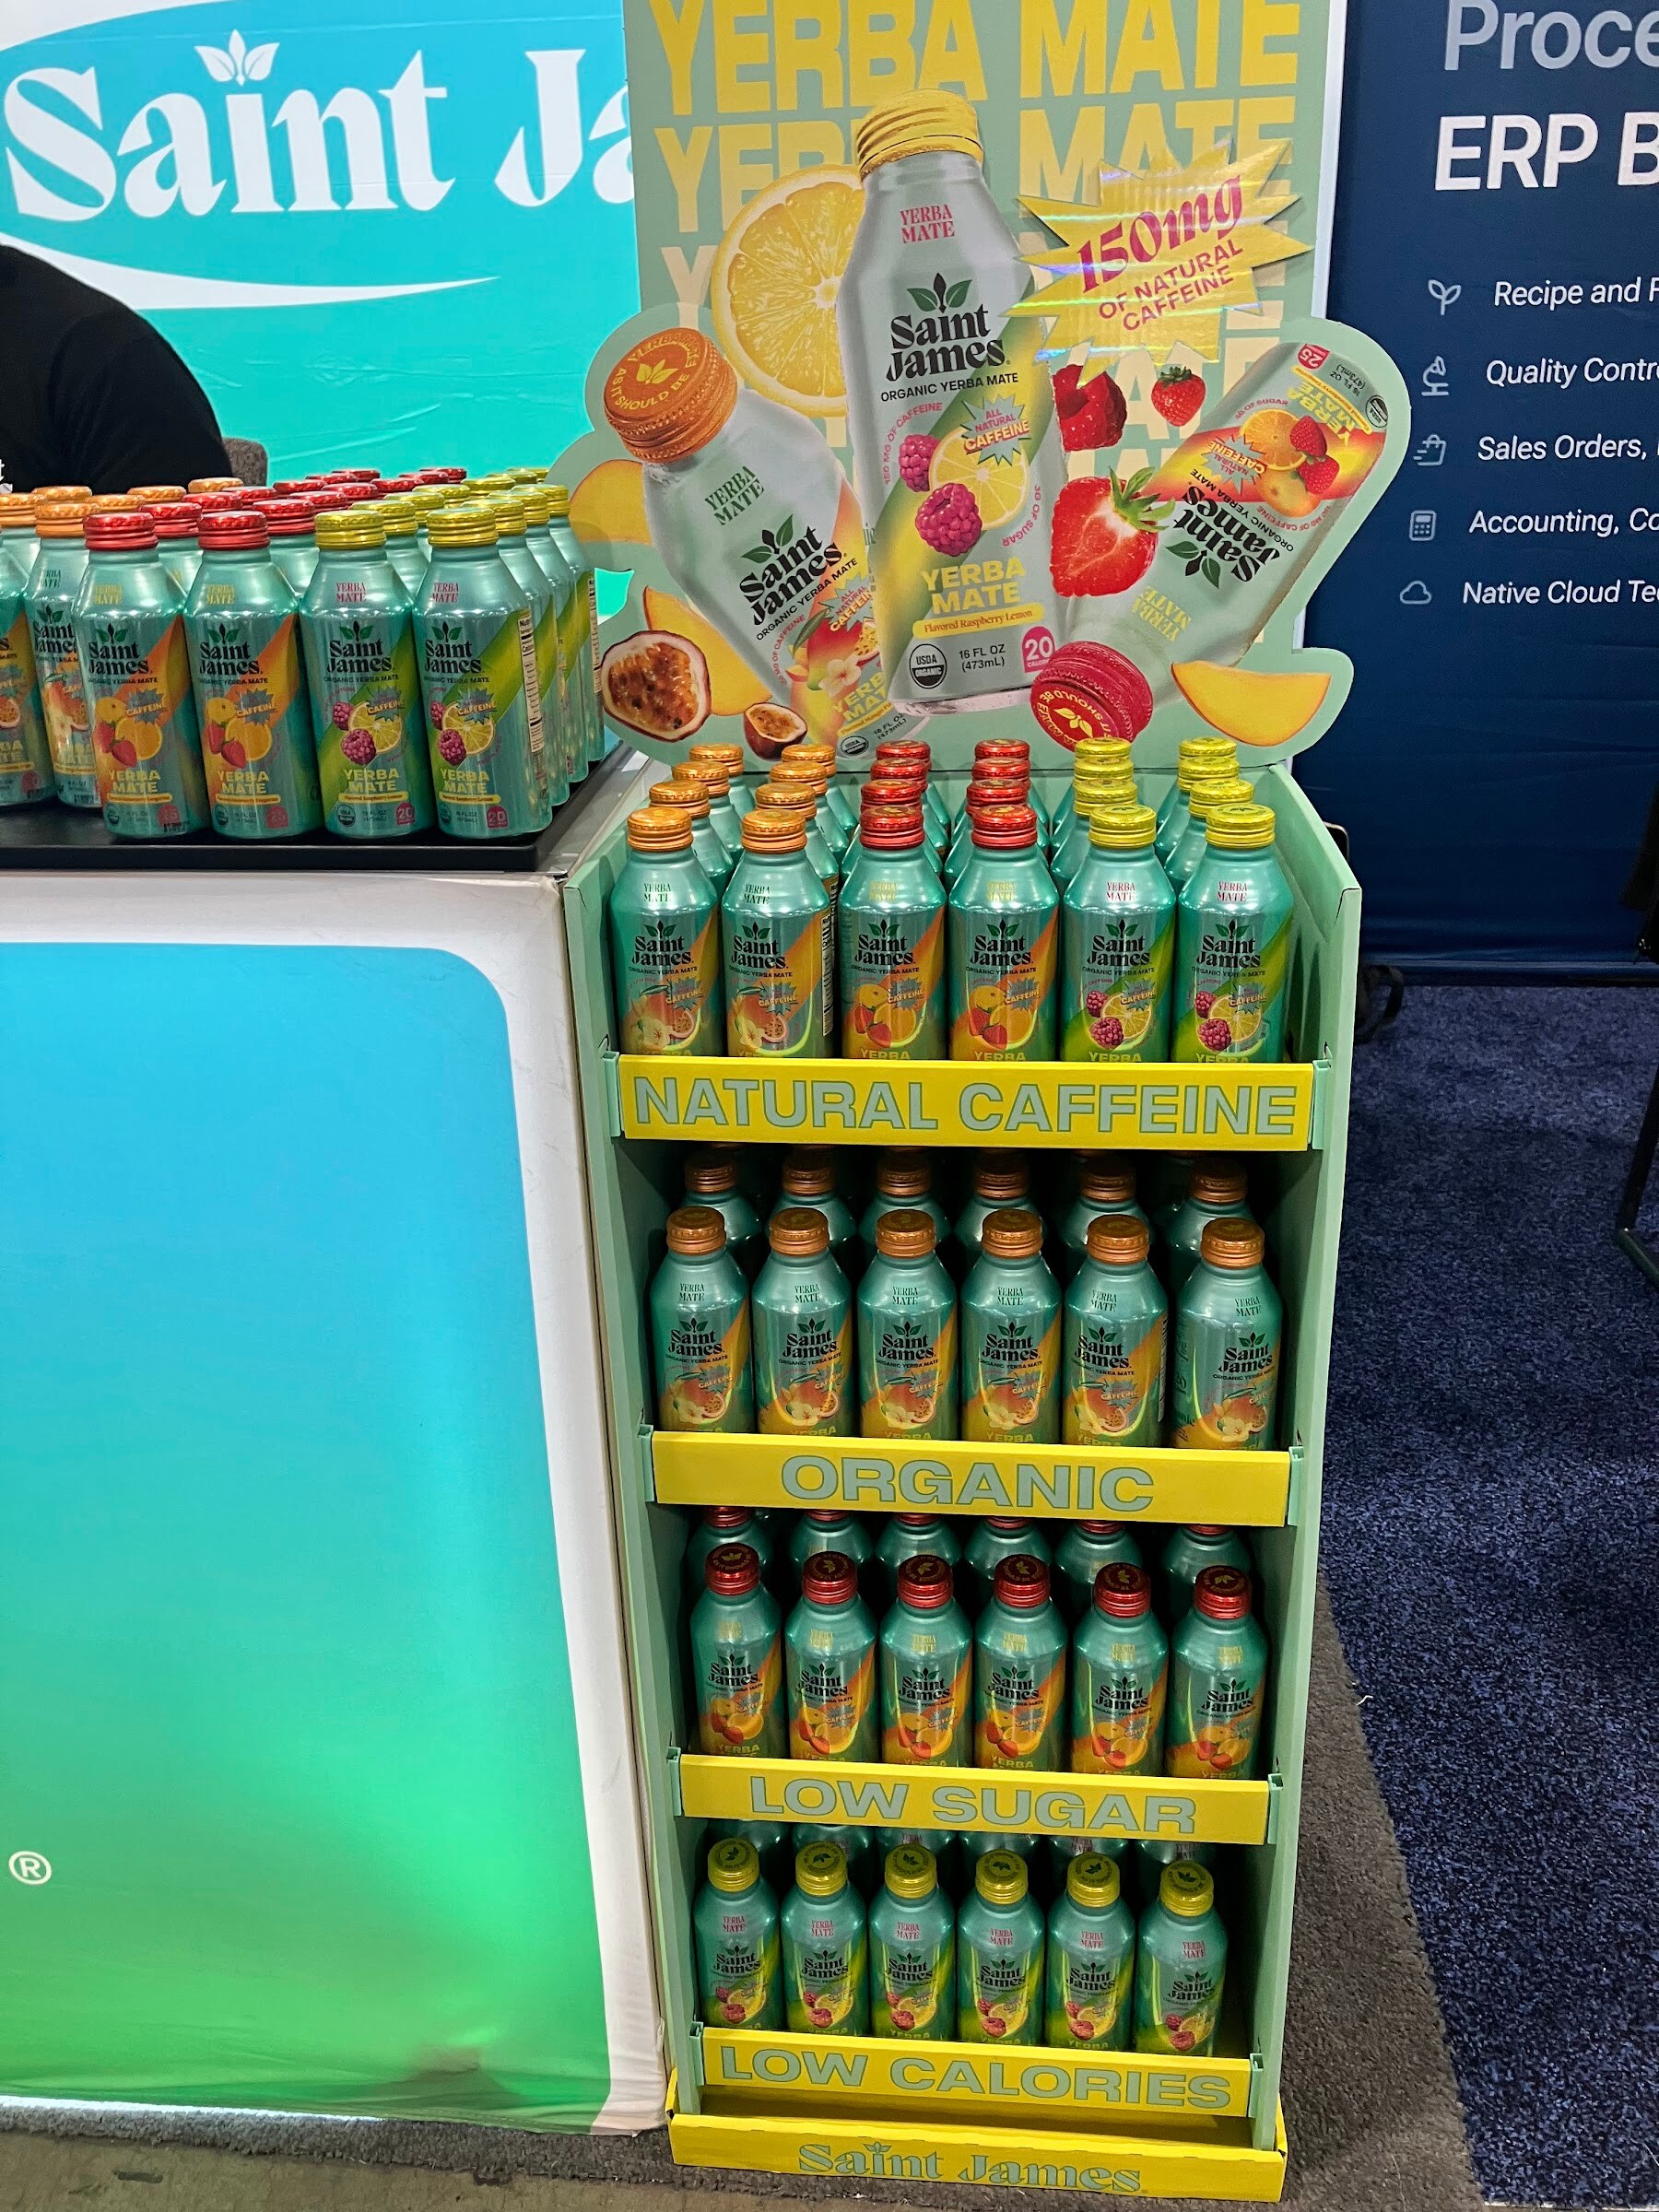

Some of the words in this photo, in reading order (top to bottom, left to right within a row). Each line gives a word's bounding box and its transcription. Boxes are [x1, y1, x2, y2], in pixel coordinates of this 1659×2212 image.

[649, 0, 987, 115] YERBA
[1019, 0, 1299, 98] MATE
[4, 49, 455, 221] Saint
[1435, 112, 1598, 191] ERP
[900, 204, 953, 227] YERBA
[901, 221, 955, 244] MATE
[1077, 174, 1241, 294] 150mg
[1098, 293, 1128, 320] OF
[1134, 239, 1243, 300] NATURAL
[1123, 265, 1234, 331] CAFFEINE
[1494, 280, 1583, 312] Recipe
[1591, 276, 1641, 303] and
[890, 303, 991, 350] Saint
[886, 339, 1005, 382] James
[1300, 347, 1322, 368] 25
[612, 368, 627, 384] AS
[671, 373, 690, 391] BE
[1486, 357, 1578, 389] Quality
[1583, 357, 1659, 382] Contr
[881, 383, 937, 402] ORGANIC
[940, 376, 984, 392] YERBA
[986, 372, 1018, 385] MATE
[615, 391, 669, 410] SHOULD
[1255, 396, 1289, 406] SUGAR
[1298, 380, 1355, 433] MATE
[896, 402, 944, 429] CAFFEINE
[974, 414, 1018, 431] NATURAL
[984, 407, 1004, 420] ALL
[1285, 386, 1351, 447] YERBA
[964, 420, 1031, 454] CAFFEINE
[1477, 436, 1547, 461] Sales
[1553, 433, 1647, 461] Orders,
[1206, 440, 1267, 474] CAFFEINE
[1213, 453, 1249, 476] NATURAL
[1190, 468, 1218, 491] MATE
[1221, 465, 1234, 476] ALL
[704, 465, 756, 512] YERBA
[713, 477, 764, 526] MATE
[1217, 488, 1250, 520] YERBA
[1182, 486, 1280, 565] James
[1470, 509, 1619, 538] Accounting,
[1002, 522, 1036, 547] SUGAR
[1249, 515, 1294, 553] ORGANIC
[1173, 509, 1262, 582] Saint
[739, 525, 823, 604] Saint
[920, 557, 1027, 592] YERBA
[750, 542, 844, 627] James
[1463, 582, 1540, 605] Native
[1547, 579, 1621, 604] Cloud
[1629, 580, 1659, 603] Te
[756, 605, 797, 641] ORGANIC
[797, 579, 832, 606] YERBA
[831, 558, 858, 582] MATE
[841, 590, 855, 602] ALL
[932, 582, 1022, 616] MATE
[830, 591, 875, 632] CAFFEIN
[1140, 585, 1193, 632] MATE
[924, 618, 959, 634] Flavored
[959, 612, 1004, 630] Raspberry
[1006, 608, 1033, 621] Lemon
[1132, 596, 1182, 643] YERBA
[200, 641, 251, 659] Saint
[330, 639, 383, 657] Saint
[425, 639, 474, 657] Saint
[959, 650, 971, 660] 16
[972, 647, 988, 658] FL
[990, 644, 1006, 655] OZ
[1024, 635, 1053, 659] 20
[199, 657, 262, 676] James
[327, 655, 393, 674] James
[424, 656, 483, 674] James
[915, 654, 938, 666] USDA
[961, 655, 1006, 672] (473mL)
[832, 671, 886, 713] YERB
[1053, 690, 1103, 723] SHOULD
[635, 935, 685, 952] Saint
[734, 935, 780, 955] Saint
[858, 934, 908, 951] Saint
[974, 935, 1027, 952] Saint
[1092, 935, 1146, 952] Saint
[1202, 935, 1256, 953] Saint
[631, 949, 694, 966] James
[731, 952, 788, 970] James
[854, 948, 916, 967] James
[970, 950, 1034, 968] James
[1087, 950, 1151, 968] James
[1196, 951, 1262, 969] James
[633, 1077, 938, 1130] NATURAL
[959, 1083, 1297, 1135] CAFFEINE
[786, 1329, 833, 1347] Saint
[882, 1331, 930, 1349] Saint
[985, 1333, 1034, 1349] Saint
[1077, 1336, 1124, 1356] Saint
[782, 1342, 839, 1359] James
[878, 1345, 936, 1361] James
[982, 1346, 1041, 1361] James
[1074, 1348, 1133, 1370] James
[1224, 1342, 1270, 1361] Saint
[1218, 1353, 1274, 1373] James
[782, 1455, 1155, 1512] ORGANIC
[901, 1675, 946, 1691] Saint
[992, 1672, 1035, 1691] Saint
[899, 1686, 952, 1702] James
[988, 1684, 1041, 1701] James
[1100, 1684, 1144, 1700] Saint
[1096, 1694, 1150, 1711] James
[750, 1776, 910, 1820] LOW
[933, 1785, 1195, 1835] SUGAR
[801, 1965, 849, 1980] James
[804, 1956, 844, 1971] Saint
[888, 1957, 928, 1972] Saint
[981, 1965, 1021, 1980] Saint
[886, 1967, 934, 1981] James
[977, 1974, 1026, 1987] James
[1168, 1986, 1216, 2001] James
[1172, 1978, 1214, 1994] Saint
[721, 2046, 867, 2087] LOW
[890, 2058, 1230, 2110] CALORIES
[799, 2144, 944, 2180] Saint
[958, 2155, 1142, 2193] James
